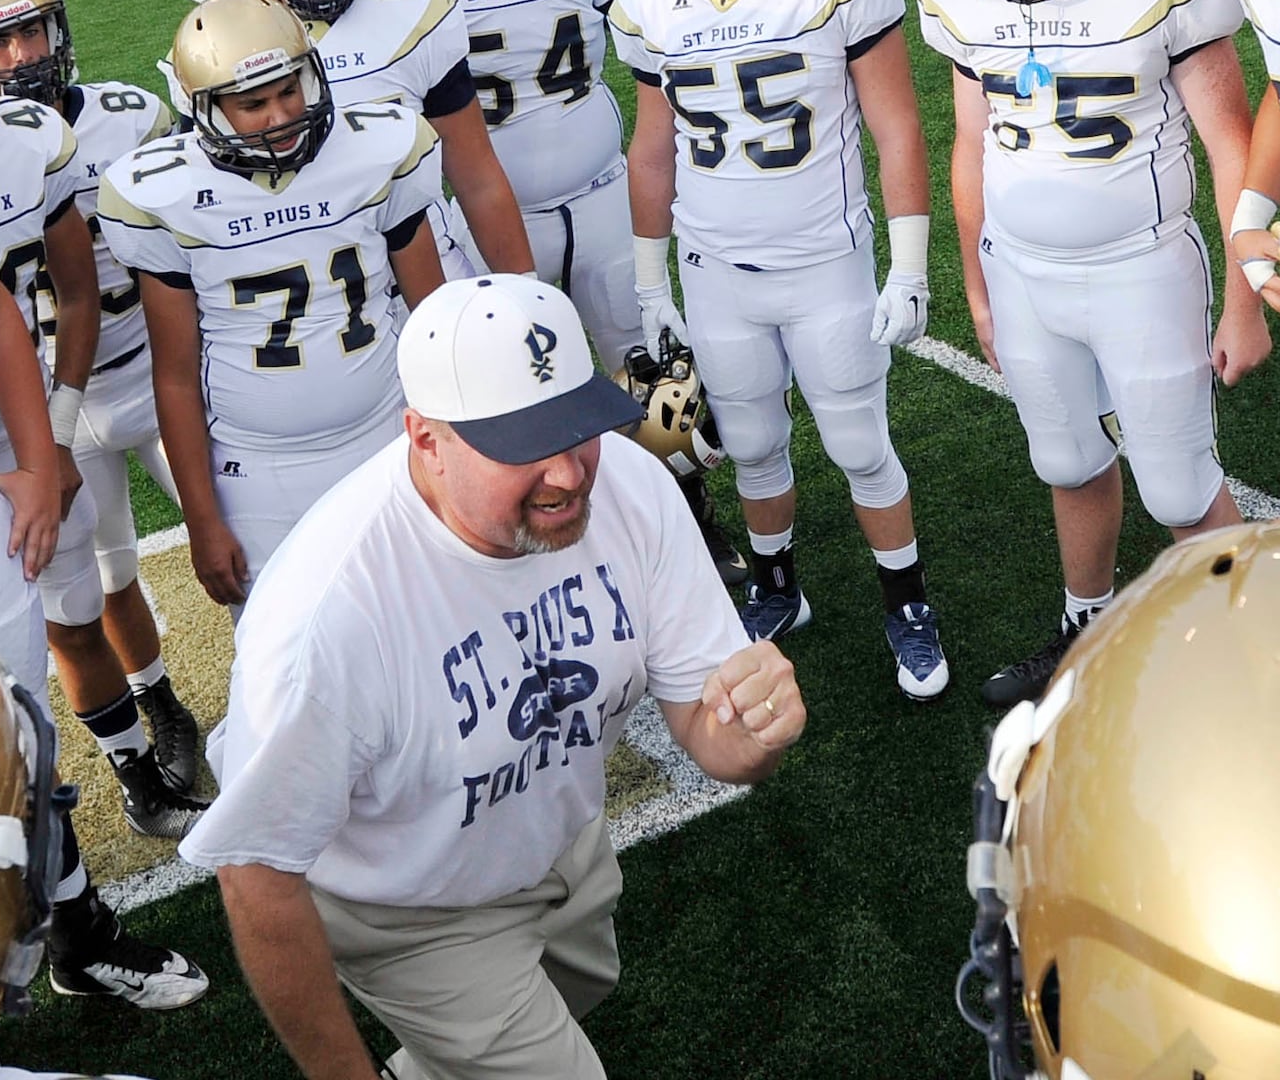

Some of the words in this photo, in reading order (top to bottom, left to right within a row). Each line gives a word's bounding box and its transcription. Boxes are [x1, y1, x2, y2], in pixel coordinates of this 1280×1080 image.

[682, 31, 706, 49] ST.
[711, 24, 749, 43] PIUS
[753, 22, 765, 37] X
[994, 23, 1021, 40] ST.
[1028, 21, 1072, 38] PIUS
[1079, 21, 1092, 38] X
[243, 51, 275, 70] Riddell
[353, 51, 366, 66] X
[467, 9, 592, 128] 54
[99, 90, 147, 114] 8
[660, 50, 816, 171] 55
[86, 163, 99, 179] X
[1, 193, 15, 211] X
[227, 217, 259, 237] ST.
[263, 204, 312, 227] PIUS
[318, 200, 332, 218] X
[227, 242, 379, 370] 71
[441, 629, 510, 740] ST.
[502, 573, 596, 671] PIUS
[595, 561, 636, 642] X
